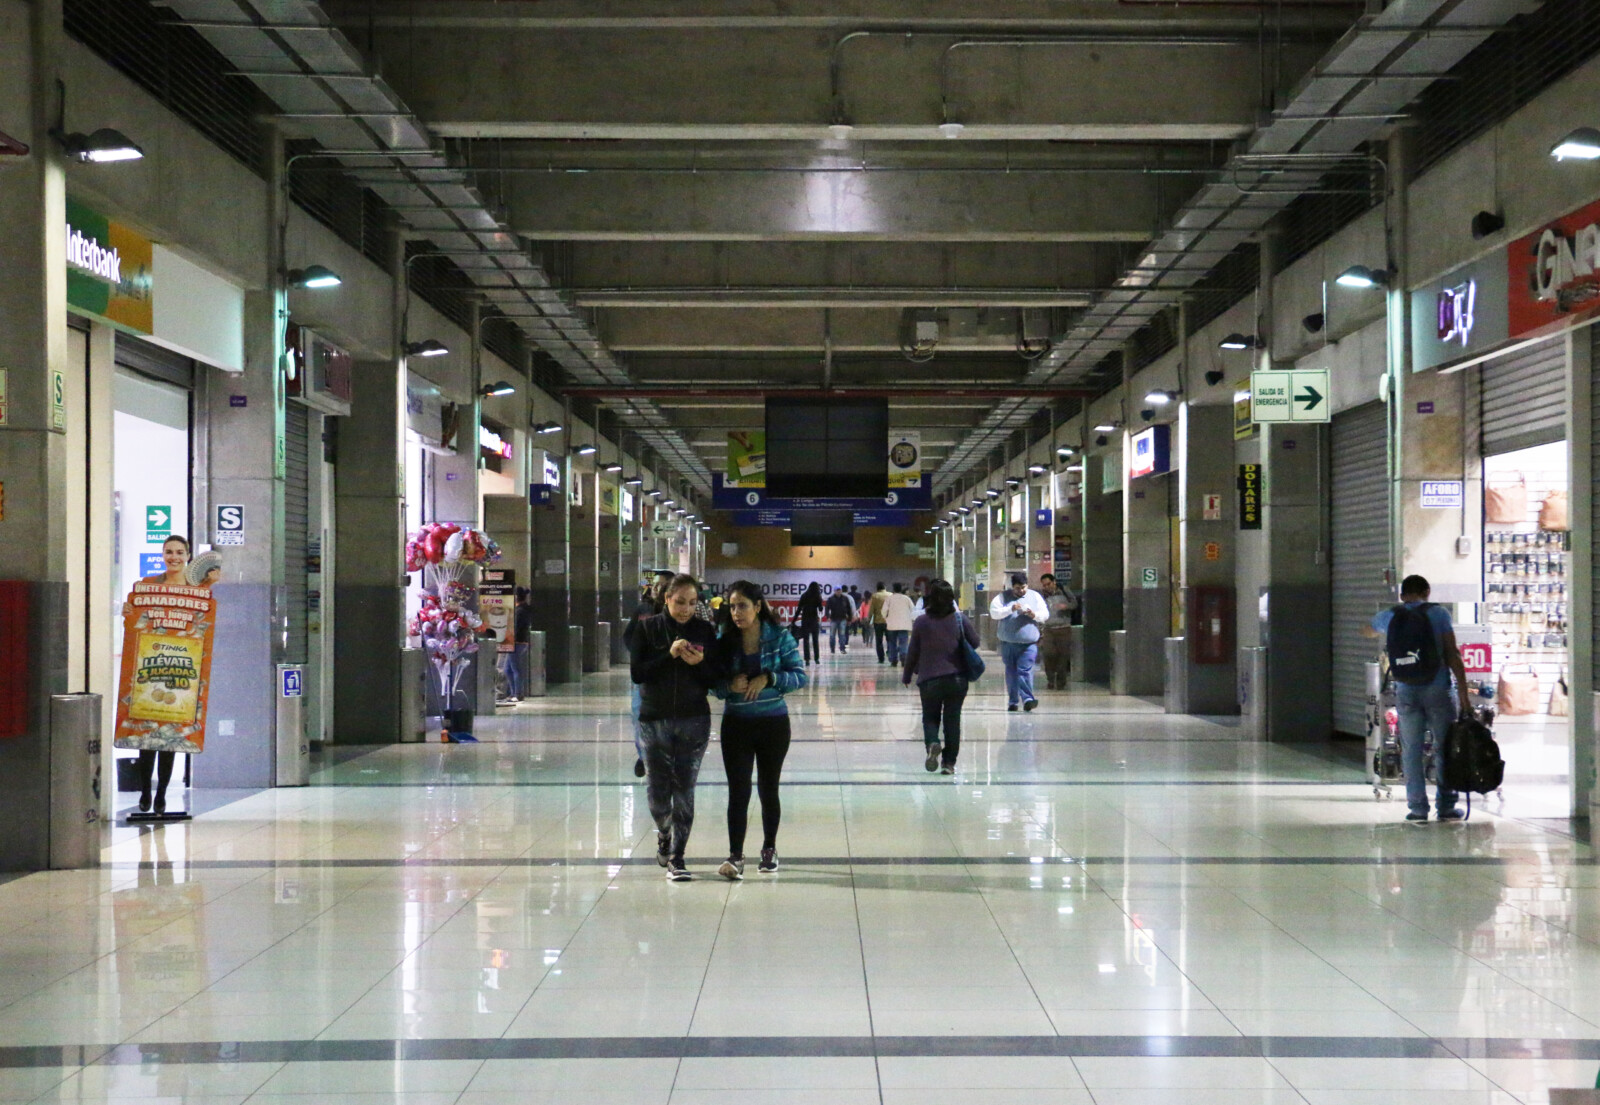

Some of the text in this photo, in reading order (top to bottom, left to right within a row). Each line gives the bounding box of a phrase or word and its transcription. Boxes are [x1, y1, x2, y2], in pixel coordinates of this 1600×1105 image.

[66, 223, 121, 284] Interbank
[55, 374, 63, 404] S
[1259, 388, 1284, 396] SALIDA DE
[1256, 398, 1287, 406] EMERGENCIA
[1245, 464, 1256, 522] DOLARES
[1424, 483, 1459, 495] AFORO
[749, 493, 756, 503] 6
[887, 493, 894, 503] 5
[219, 507, 241, 529] S
[602, 562, 609, 570] S
[1145, 569, 1155, 581] S
[161, 585, 167, 593] A
[168, 586, 210, 599] NUESTROS
[773, 583, 832, 595] PREPGO
[133, 596, 209, 611] GANADORES
[144, 654, 192, 668] LLÉVATE
[138, 668, 149, 682] 3
[150, 667, 197, 677] JUGADAS
[174, 677, 188, 688] 10
